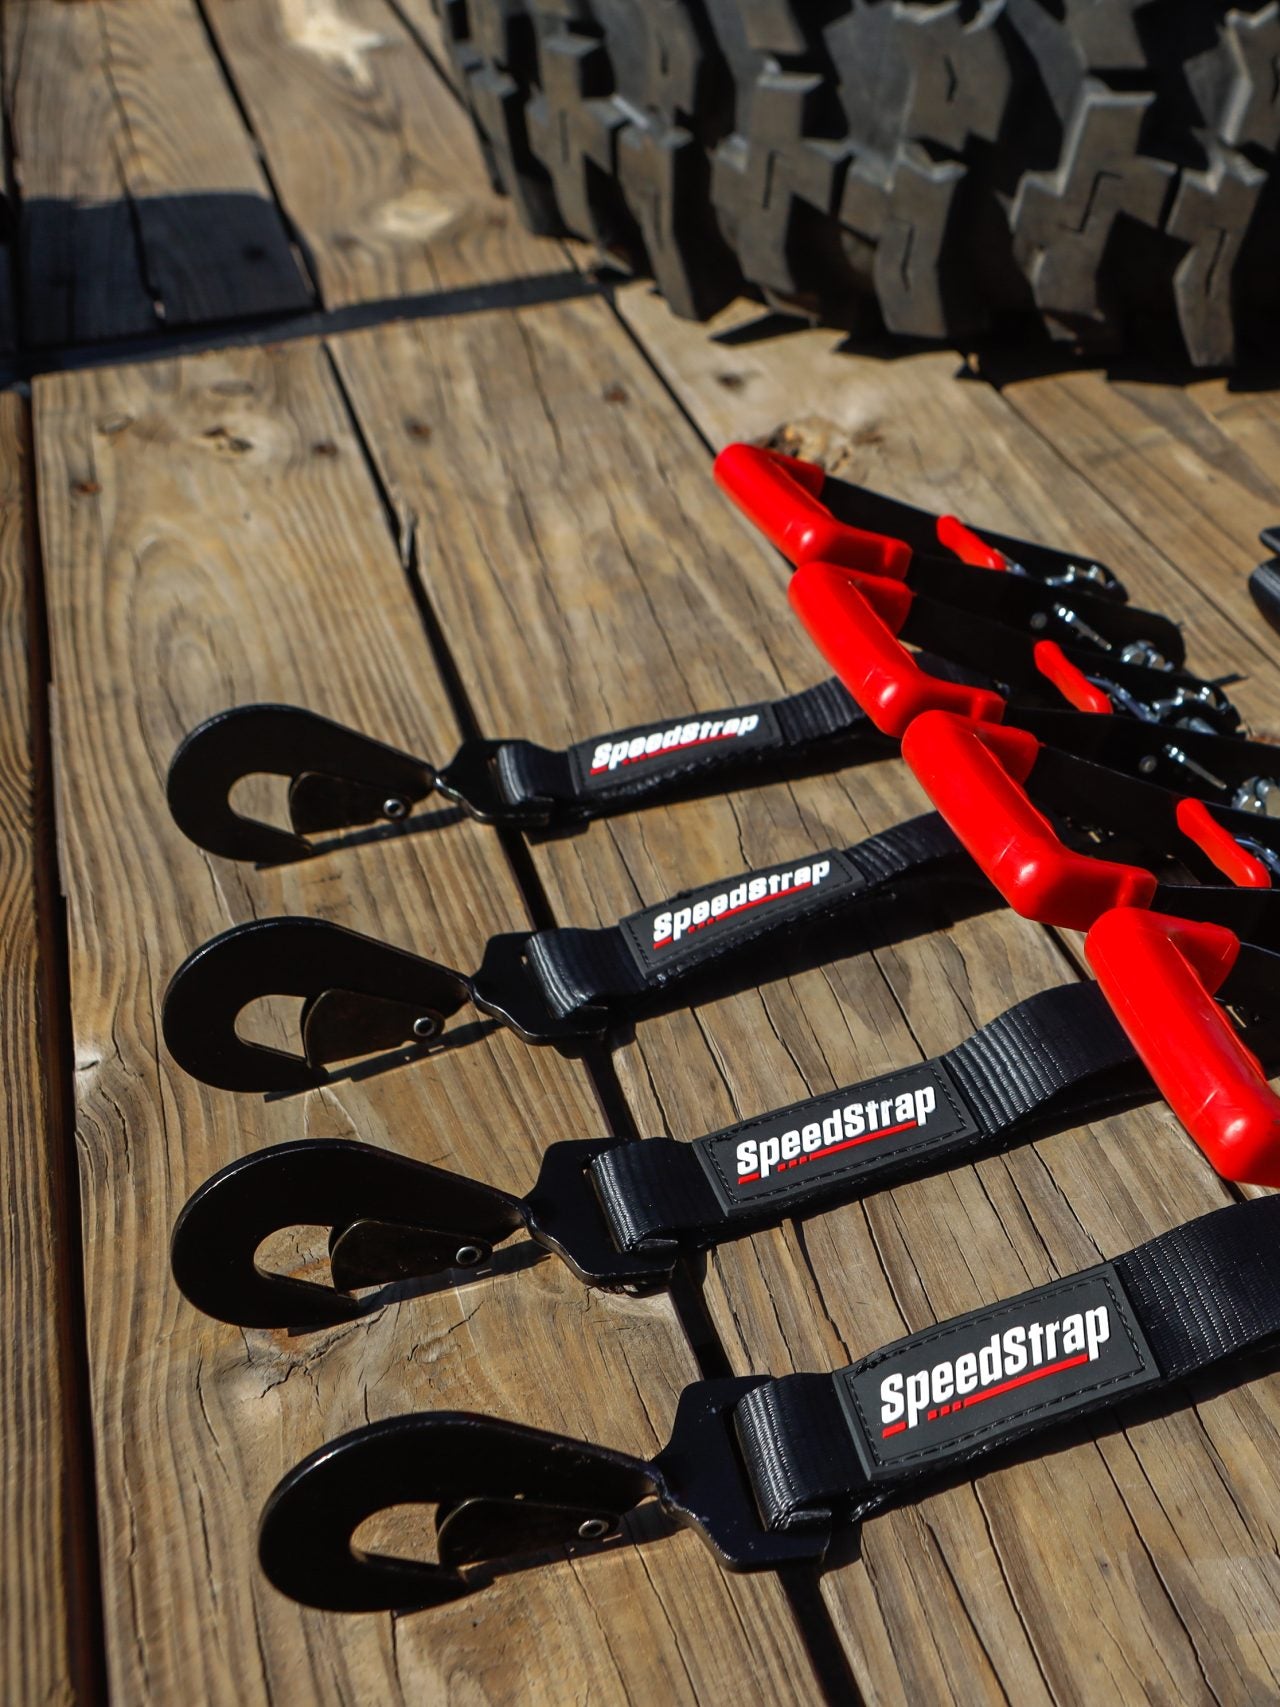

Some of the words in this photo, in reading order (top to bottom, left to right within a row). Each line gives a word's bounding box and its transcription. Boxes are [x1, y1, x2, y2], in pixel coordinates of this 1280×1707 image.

[592, 714, 759, 770] SpeedStrap
[653, 860, 830, 942] SpeedStrap
[736, 1086, 936, 1178] SpeedStrap
[880, 1306, 1110, 1428] SpeedStrap
